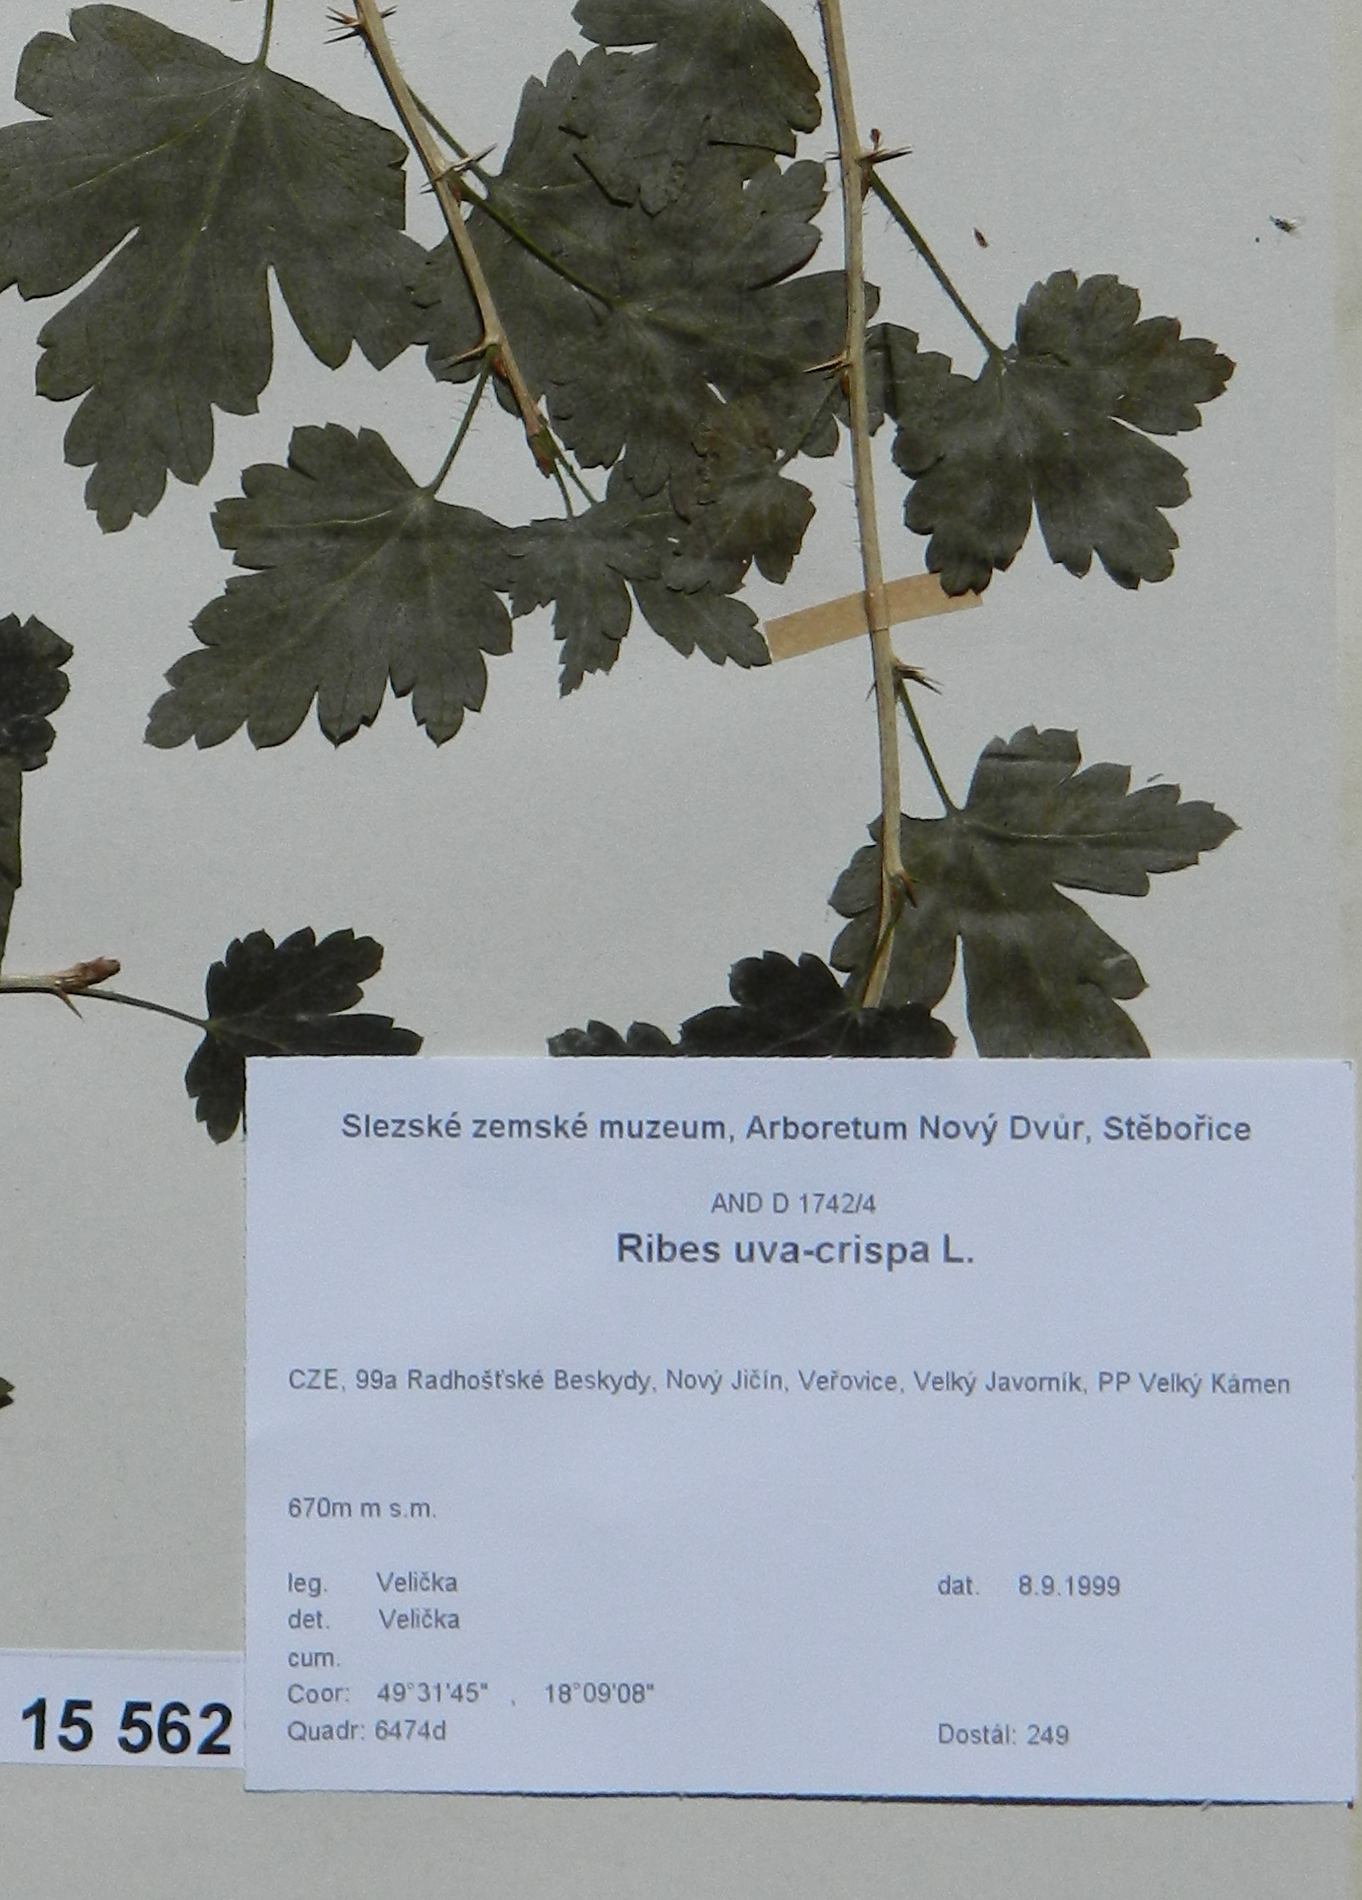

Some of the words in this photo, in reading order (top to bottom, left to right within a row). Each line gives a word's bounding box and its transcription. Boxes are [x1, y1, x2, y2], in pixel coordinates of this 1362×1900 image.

[342, 1112, 462, 1138] Slezské
[473, 1112, 588, 1138] zemské
[600, 1120, 735, 1144] muzeum,
[746, 1115, 907, 1141] Arboretum
[920, 1112, 998, 1146] Nový
[1104, 1114, 1252, 1142] Stěbořice
[711, 1192, 763, 1214] AND
[773, 1192, 790, 1214] D
[800, 1192, 877, 1214] 1742/4
[618, 1232, 721, 1264] Ribes
[736, 1233, 930, 1273] uva-crispa
[943, 1233, 974, 1264] L.
[288, 1368, 346, 1392] CZE,
[356, 1368, 397, 1390] 99a
[554, 1368, 657, 1396] Beskydy,
[666, 1368, 723, 1396] Nový
[731, 1368, 790, 1394] Jičín,
[798, 1369, 905, 1395] Veřovice,
[914, 1370, 977, 1397] Velký
[1098, 1371, 1131, 1392] PP
[1139, 1372, 1203, 1399] Velký
[288, 1496, 352, 1518] 670m
[360, 1502, 381, 1518] m
[389, 1502, 437, 1518] s.m.
[288, 1572, 328, 1597] leg.
[376, 1571, 458, 1593] Velička
[937, 1574, 980, 1596] dat.
[1018, 1574, 1121, 1597] 8.9.1999
[288, 1608, 330, 1630] det.
[378, 1608, 461, 1630] Velička
[288, 1651, 340, 1668] cum.
[288, 1683, 350, 1704] Coor:
[22, 1697, 93, 1751] 15
[117, 1701, 233, 1755] 562
[288, 1719, 365, 1742] Quadr:
[375, 1719, 446, 1741] 6474d
[938, 1721, 1016, 1745] Dostál:
[1027, 1723, 1070, 1746] 249
